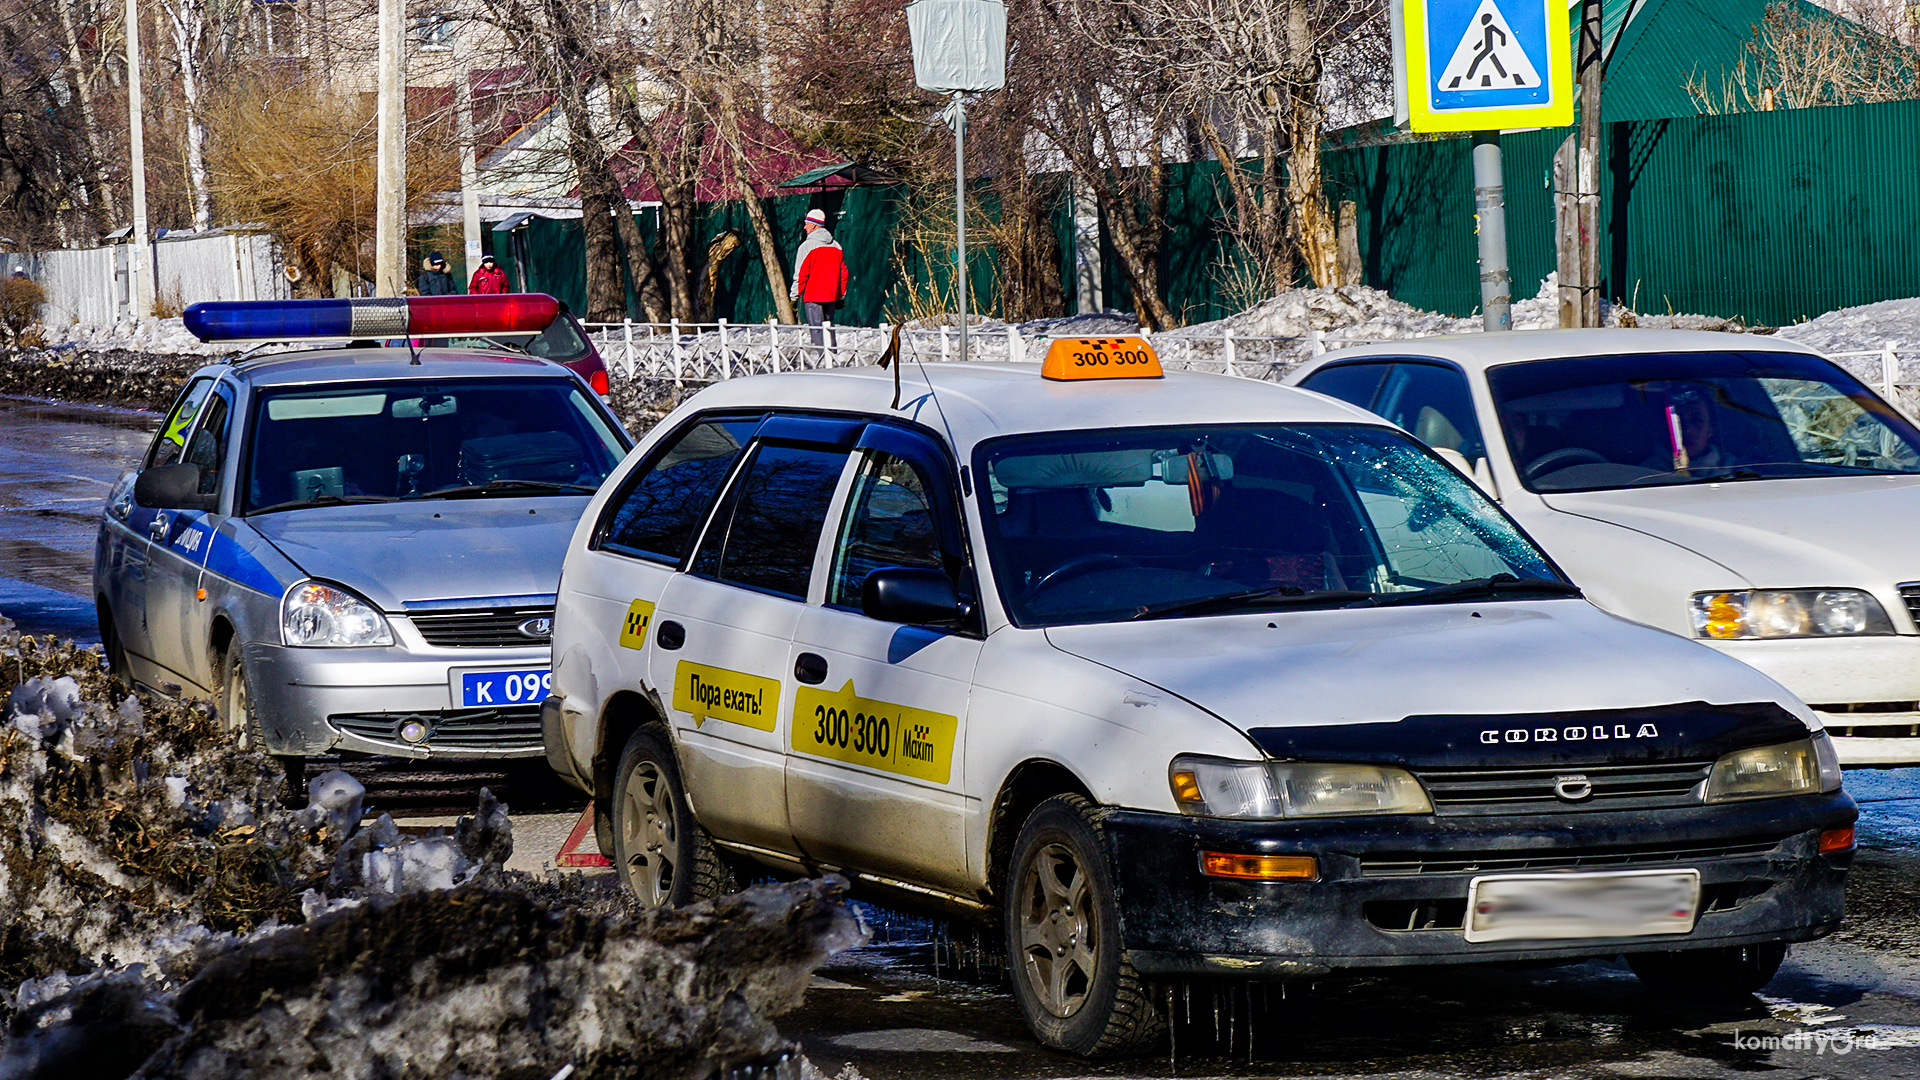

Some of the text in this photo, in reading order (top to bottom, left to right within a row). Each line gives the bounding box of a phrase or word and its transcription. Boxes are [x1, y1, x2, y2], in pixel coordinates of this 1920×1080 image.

[690, 673, 763, 716] Пора ехать!
[902, 728, 934, 763] Maxim
[1479, 723, 1659, 744] COROLLA
